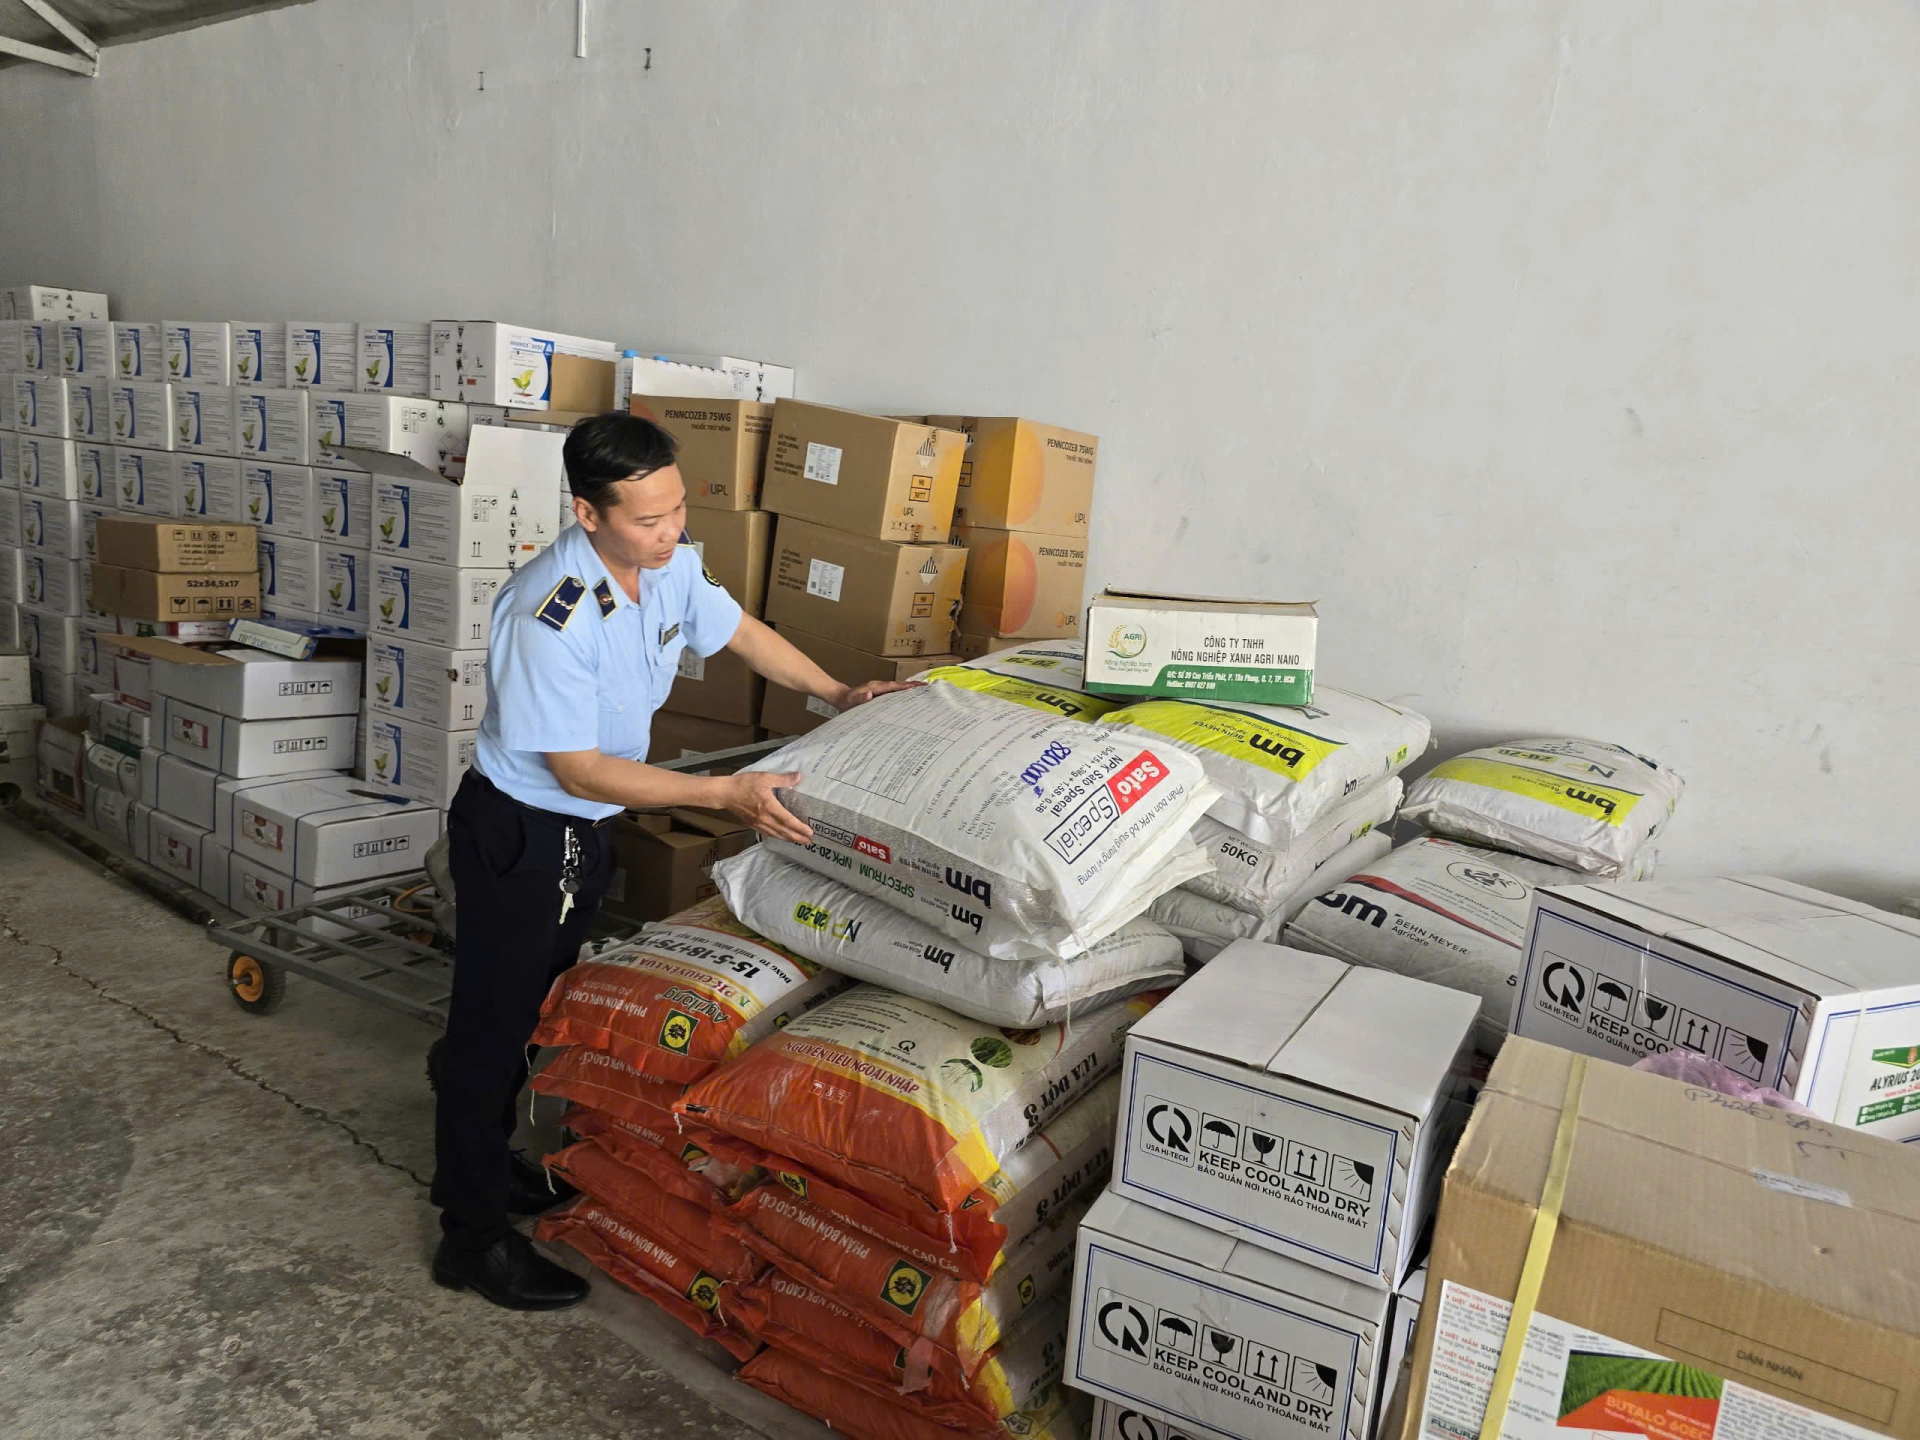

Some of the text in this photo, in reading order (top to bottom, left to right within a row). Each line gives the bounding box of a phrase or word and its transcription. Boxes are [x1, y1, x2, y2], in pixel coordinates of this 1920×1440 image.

[665, 410, 731, 421] PENNCOZEB 75WG
[1047, 439, 1094, 456] PENNCOZEB 75WG
[710, 484, 728, 496] UPL
[903, 507, 914, 516] UPL
[1074, 512, 1087, 524] UPL
[1038, 547, 1084, 559] PENNCOZEB 75WG
[186, 580, 239, 588] 52x34,5x17
[905, 624, 916, 633] UPL
[1065, 615, 1076, 626] UPL
[1204, 635, 1264, 649] CÔNG TY TNHH
[1171, 648, 1300, 665] NÔNG NGHIỆP XANH AGRI NANO
[1035, 692, 1083, 717] bm
[1192, 720, 1221, 734] MEYER
[1249, 732, 1306, 768] bm
[1049, 753, 1123, 819] NPK Sato Special
[1166, 784, 1185, 804] Phân
[1055, 760, 1161, 858] Sato Special
[1565, 787, 1618, 816] bm
[1138, 810, 1156, 829] NPK
[859, 840, 887, 859] Sato
[1220, 842, 1259, 867] 50KG
[831, 849, 915, 898] SPECTRUM NPK
[899, 857, 942, 881] BEHN MEYER
[945, 866, 992, 909] bm
[796, 904, 828, 927] 20-20
[951, 903, 983, 935] bm
[1391, 925, 1430, 948] AgriCare
[1395, 918, 1468, 955] BEHN MEYER
[640, 957, 662, 969] LÚA
[923, 944, 955, 973] bm
[573, 990, 589, 1003] CAO
[590, 993, 604, 1006] NPK
[662, 986, 729, 1023] Agrilong
[624, 1002, 648, 1017] PHÂN
[1539, 1000, 1580, 1023] USA HI-TECH
[1589, 1011, 1630, 1039] KEEP
[1587, 1025, 1605, 1042] BẢO
[1606, 1034, 1630, 1054] QUẢN
[785, 1040, 826, 1064] NGUYÊN
[826, 1050, 852, 1069] LIỆU
[852, 1059, 887, 1082] NGOẠI
[886, 1071, 920, 1095] NHẬP
[1870, 1071, 1909, 1092] ALYRIUS
[1024, 1103, 1039, 1128] 3
[1146, 1143, 1189, 1163] USA HI-TECH
[1199, 1151, 1371, 1219] KEEP COOL AND DRY
[1197, 1163, 1368, 1230] BẢO QUẢN NƠI KHÔ RÁO THOÁNG MÁT
[777, 1200, 798, 1219] CAO
[797, 1210, 819, 1230] NPK
[588, 1209, 679, 1268] PHÂN BÓN NPK CAO CẤP
[818, 1222, 841, 1242] BÓN
[840, 1237, 871, 1260] PHÂN
[785, 1284, 806, 1302] CAO
[1452, 1296, 1466, 1305] DIỆT
[1445, 1331, 1459, 1341] DIỆT
[1155, 1348, 1334, 1422] KEEP COOL AND DRY
[1433, 1368, 1459, 1382] BUTALO
[1153, 1362, 1330, 1434] BẢO QUẢN NƠI KHÔ RÁO THOÁNG MÁT
[1606, 1396, 1713, 1440] BUTALO 60EC
